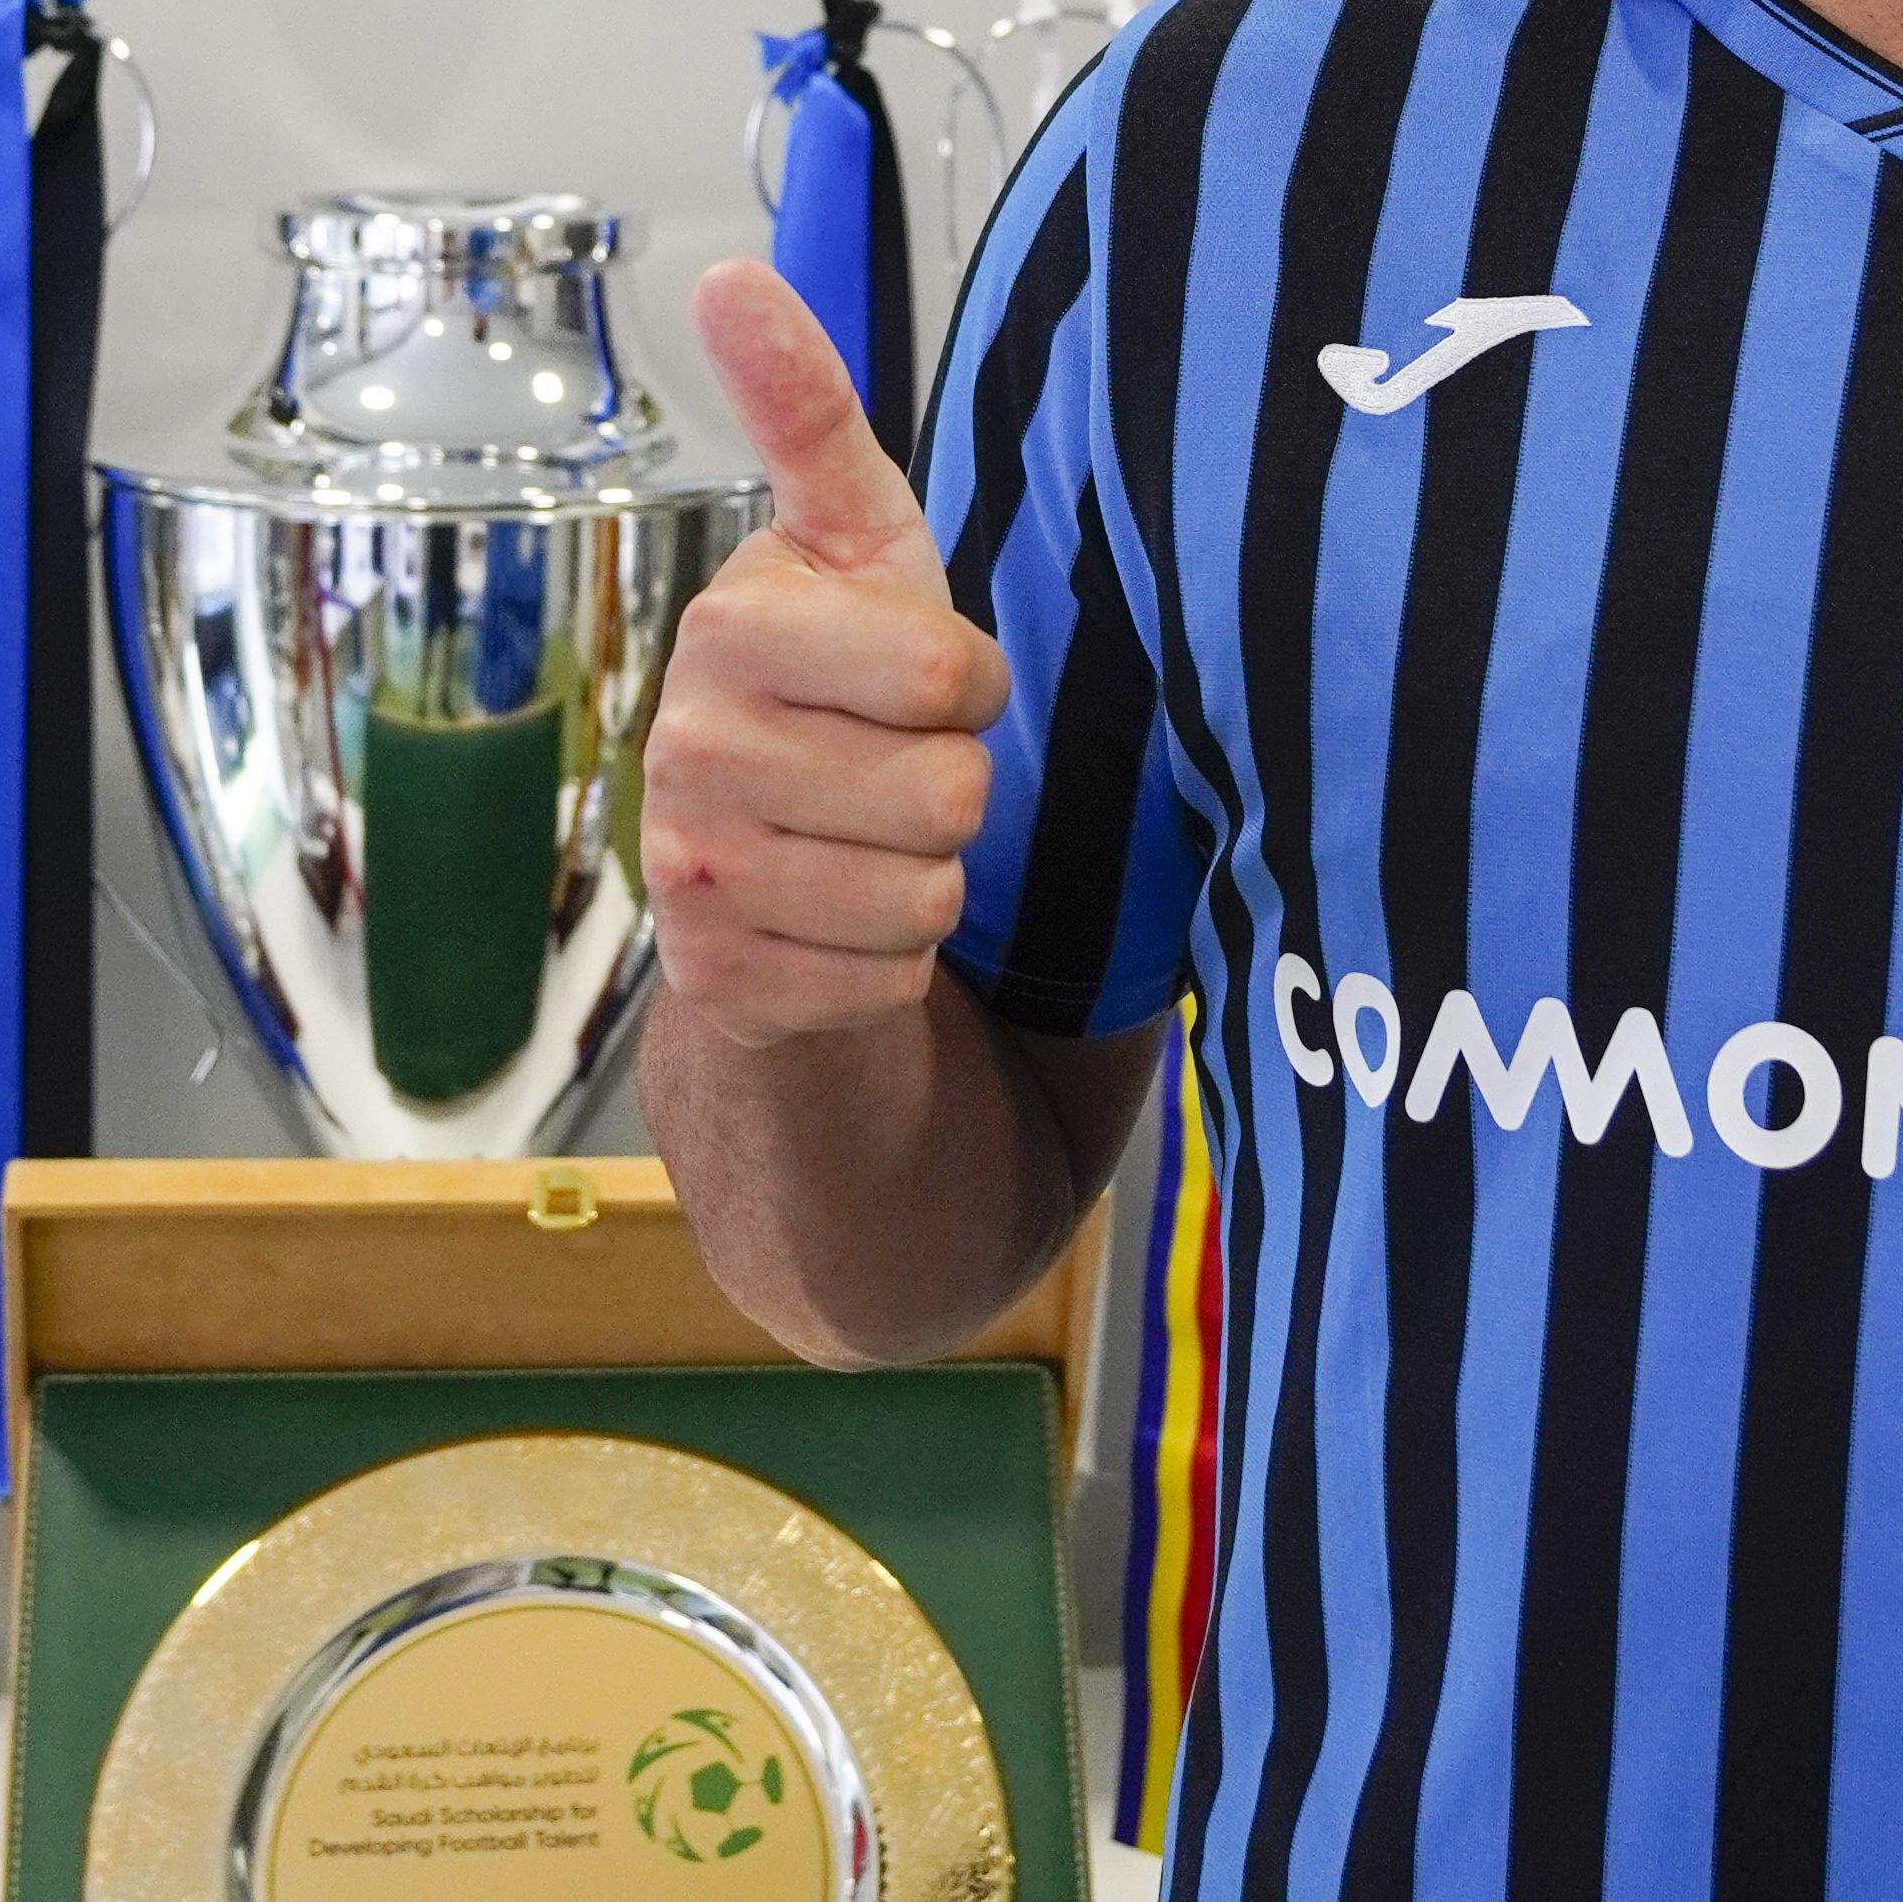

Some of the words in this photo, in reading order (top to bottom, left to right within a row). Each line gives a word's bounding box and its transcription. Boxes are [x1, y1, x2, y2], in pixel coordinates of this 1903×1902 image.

[370, 1807, 433, 1827] Saudi
[439, 1805, 566, 1826] Scholarship
[570, 1802, 597, 1820] for
[308, 1836, 433, 1858] Developing
[438, 1832, 528, 1852] Football
[534, 1830, 601, 1849] Talent
